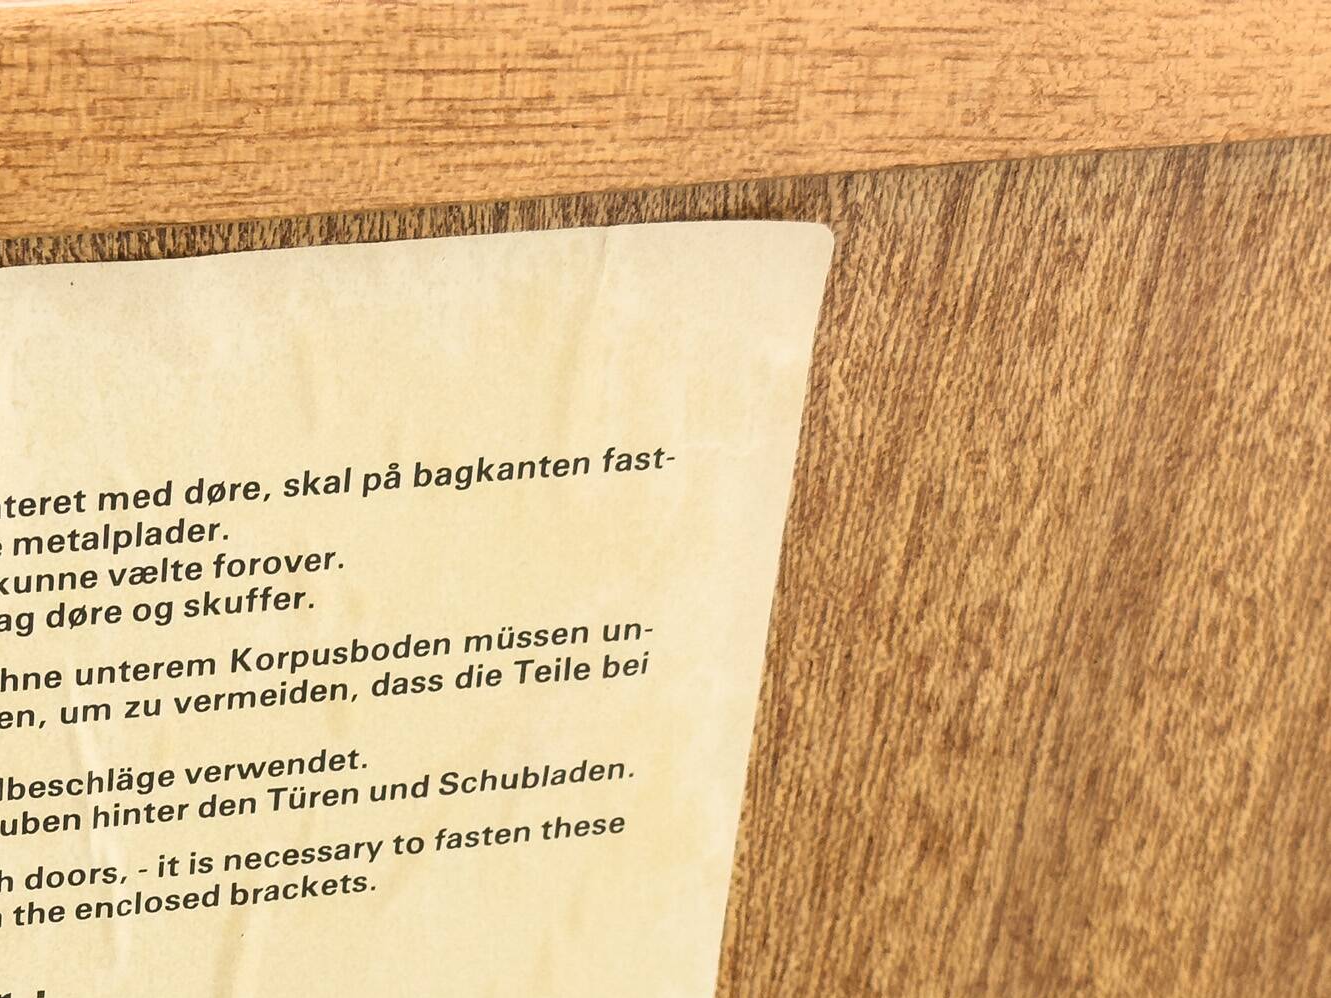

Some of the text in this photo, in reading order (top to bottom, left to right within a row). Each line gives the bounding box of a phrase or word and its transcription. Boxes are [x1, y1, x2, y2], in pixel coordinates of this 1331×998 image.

[98, 480, 173, 512] med
[184, 477, 271, 506] døre,
[283, 466, 352, 498] skal
[362, 462, 401, 498] på
[413, 455, 590, 491] bagkanten
[602, 446, 676, 473] fast-
[13, 517, 229, 557] metalplader.
[108, 557, 203, 587] vælte
[212, 551, 344, 579] forover.
[45, 602, 122, 630] døre
[132, 601, 173, 627] og
[183, 586, 314, 618] skuffer.
[75, 657, 216, 687] unterem
[230, 633, 451, 675] Korpusboden
[464, 626, 589, 653] müssen
[603, 623, 653, 642] un-
[60, 703, 111, 725] um
[124, 698, 161, 719] zu
[173, 679, 358, 714] vermeiden,
[371, 671, 443, 697] dass
[455, 663, 503, 690] die
[513, 656, 591, 685] Teile
[602, 651, 649, 679] bei
[92, 802, 190, 830] hinter
[198, 793, 257, 819] den
[266, 786, 359, 812] Türen
[369, 774, 430, 802] und
[438, 759, 634, 796] Schubladen.
[184, 748, 368, 785] verwendet.
[24, 865, 127, 891] doors,
[158, 854, 180, 878] it
[189, 851, 214, 875] is
[224, 840, 384, 872] necessary
[392, 834, 425, 855] to
[434, 826, 531, 851] fasten
[541, 816, 625, 840] these
[12, 901, 66, 927] the
[75, 883, 220, 921] enclosed
[230, 874, 376, 906] brackets.
